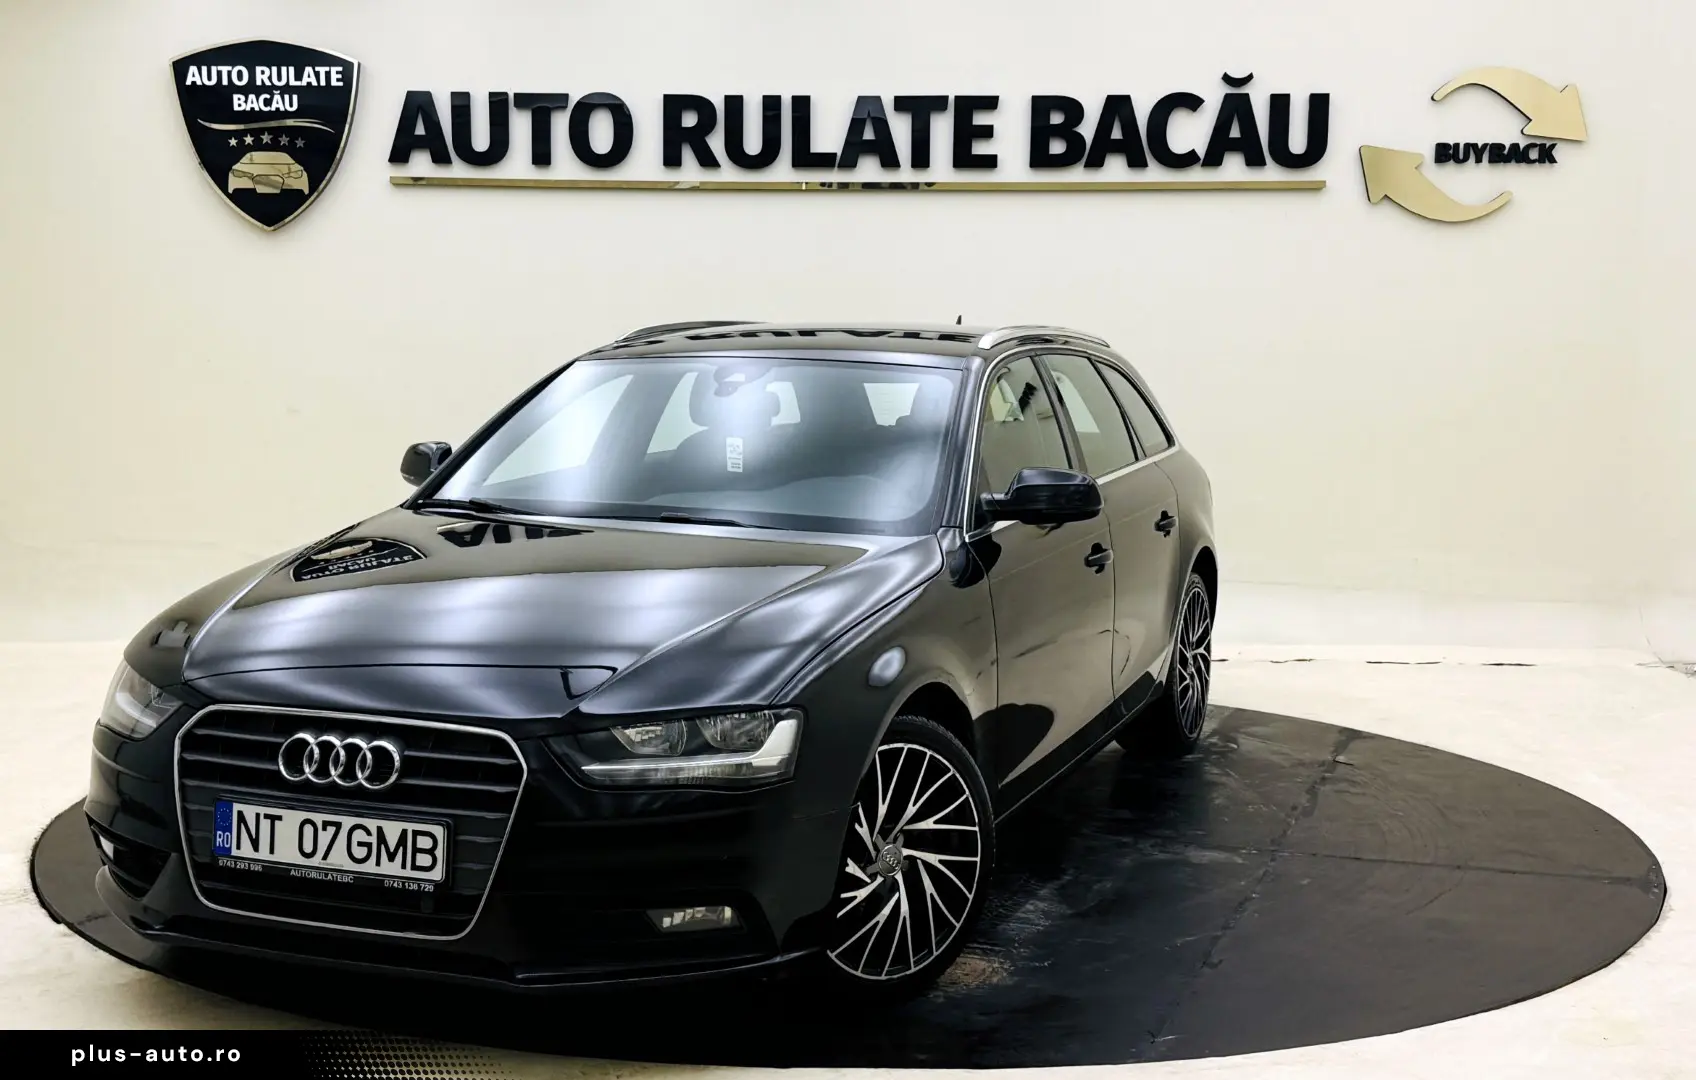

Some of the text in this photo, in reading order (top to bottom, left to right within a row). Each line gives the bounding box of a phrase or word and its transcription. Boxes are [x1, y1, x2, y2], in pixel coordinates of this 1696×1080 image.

[185, 65, 344, 86] AUTO RULATE
[232, 90, 298, 112] BACĂU
[388, 71, 1330, 169] AUTO RULATE BACĂU
[1434, 142, 1558, 164] BUYBACK
[216, 831, 231, 848] RO
[236, 810, 283, 855] NT
[290, 868, 354, 883] AUTORULATEBC
[384, 879, 402, 889] 0743
